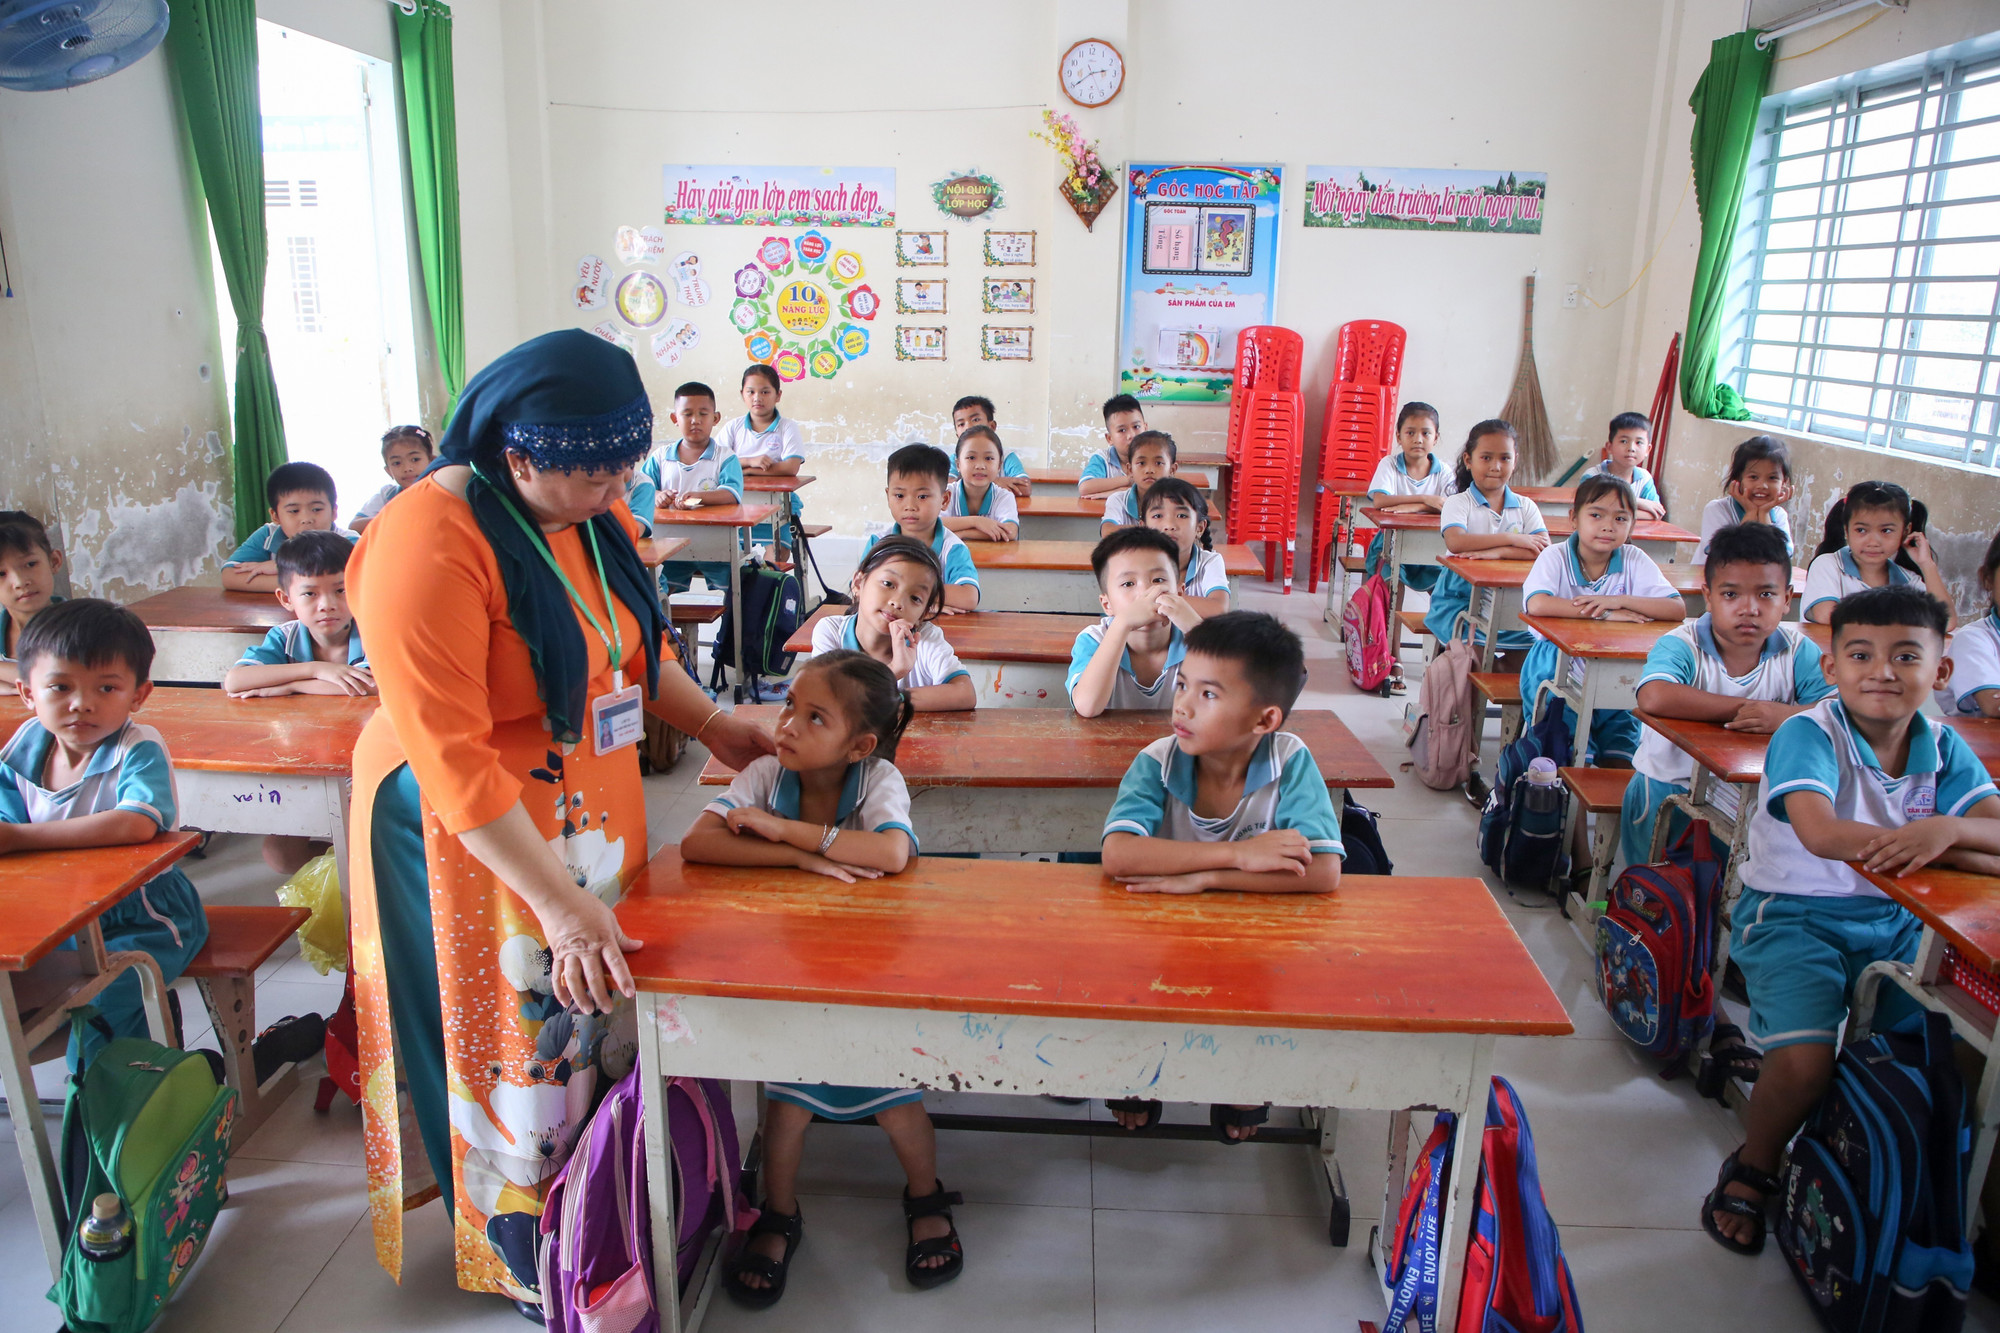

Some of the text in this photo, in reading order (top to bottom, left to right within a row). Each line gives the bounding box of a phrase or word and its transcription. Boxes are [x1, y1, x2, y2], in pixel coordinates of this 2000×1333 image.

[676, 179, 884, 221] Hãy giữ gìn lớp em sạch đẹp.
[946, 184, 988, 196] NỘI QUY
[1158, 178, 1259, 202] GÓC HỌC TẬP
[946, 198, 988, 209] LỚP HỌC
[1311, 178, 1340, 214] Mỗi
[1337, 180, 1370, 222] ngày
[1369, 179, 1396, 216] đến
[1396, 184, 1440, 225] trường
[1441, 185, 1456, 218] là
[1456, 188, 1484, 227] một
[1483, 185, 1518, 227] ngày
[580, 262, 591, 279] YÊU
[790, 285, 816, 302] 10
[782, 304, 825, 315] NĂNG LỰC
[1423, 1215, 1437, 1284] ENJOY LIFE
[1386, 1267, 1420, 1333] ENJOY LIFE
[1422, 1313, 1433, 1333] IFE
